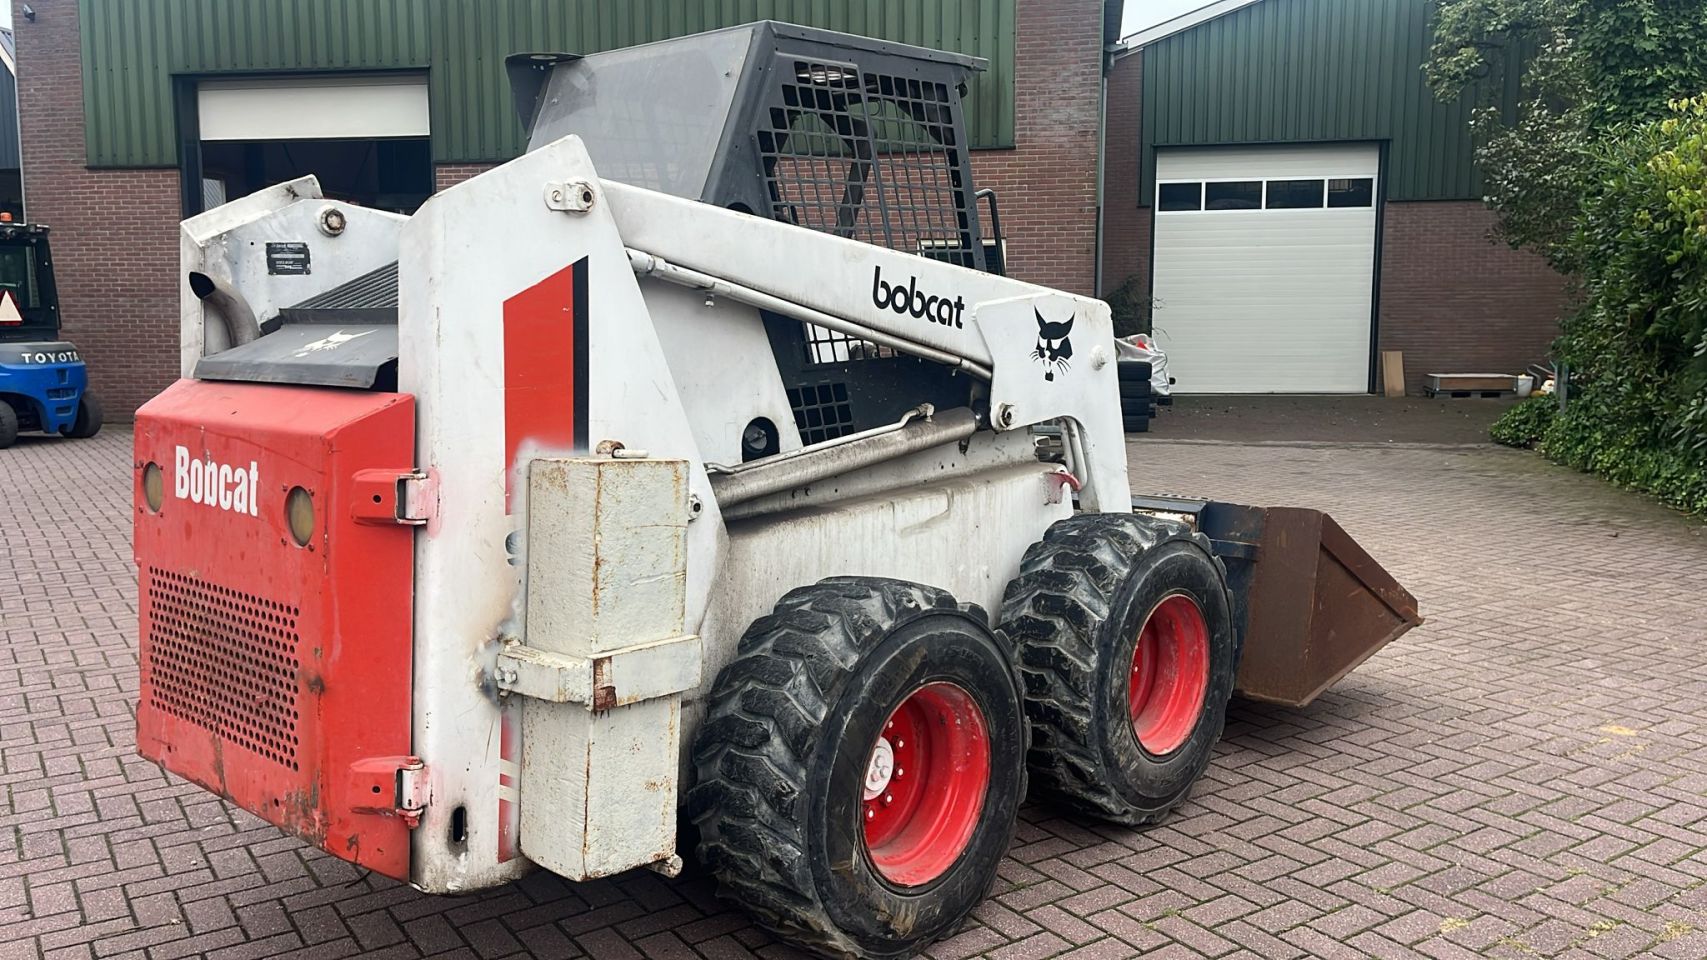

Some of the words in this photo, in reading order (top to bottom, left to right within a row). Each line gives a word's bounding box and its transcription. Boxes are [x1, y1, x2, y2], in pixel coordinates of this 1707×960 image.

[872, 265, 965, 330] bobcat
[21, 351, 79, 364] TOYOTA
[175, 445, 259, 517] Bobcat
